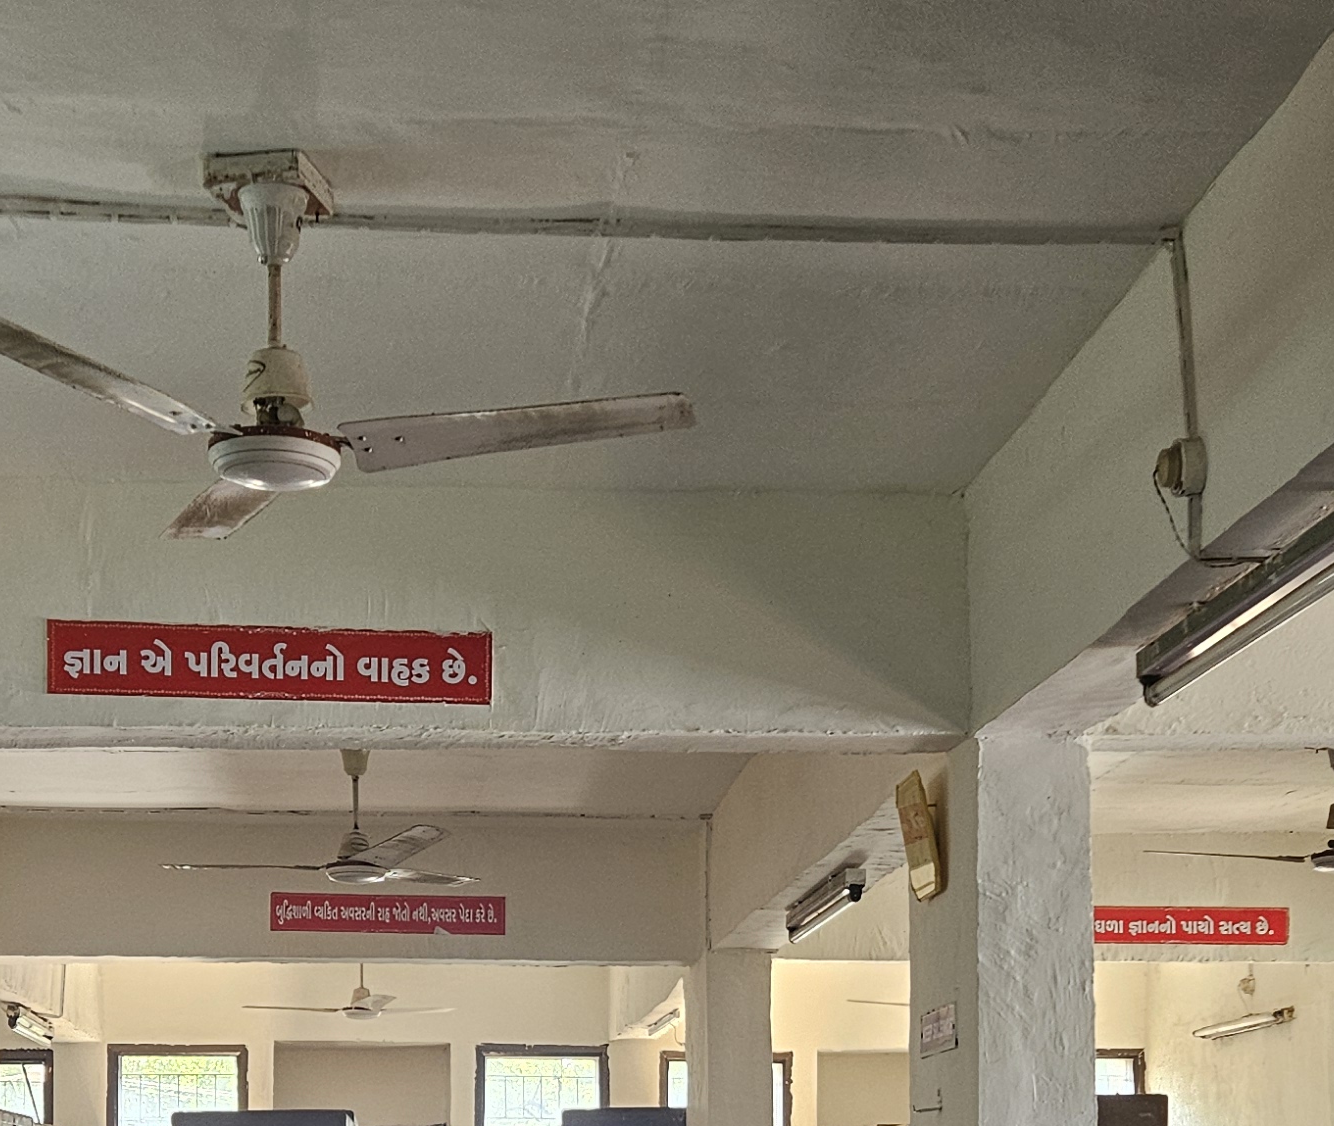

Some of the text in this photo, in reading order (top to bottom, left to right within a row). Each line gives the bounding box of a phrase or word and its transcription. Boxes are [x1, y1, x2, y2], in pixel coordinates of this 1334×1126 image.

[63, 639, 479, 686] જ્ઞાન એ પરિવર્તનનો વાહક છે.
[340, 901, 375, 921] અવસરની
[377, 906, 390, 922] રાહ
[475, 903, 485, 923] કરે
[1094, 915, 1275, 936] ઘળા જ્ઞાનનો પાયો સત્ય છે.
